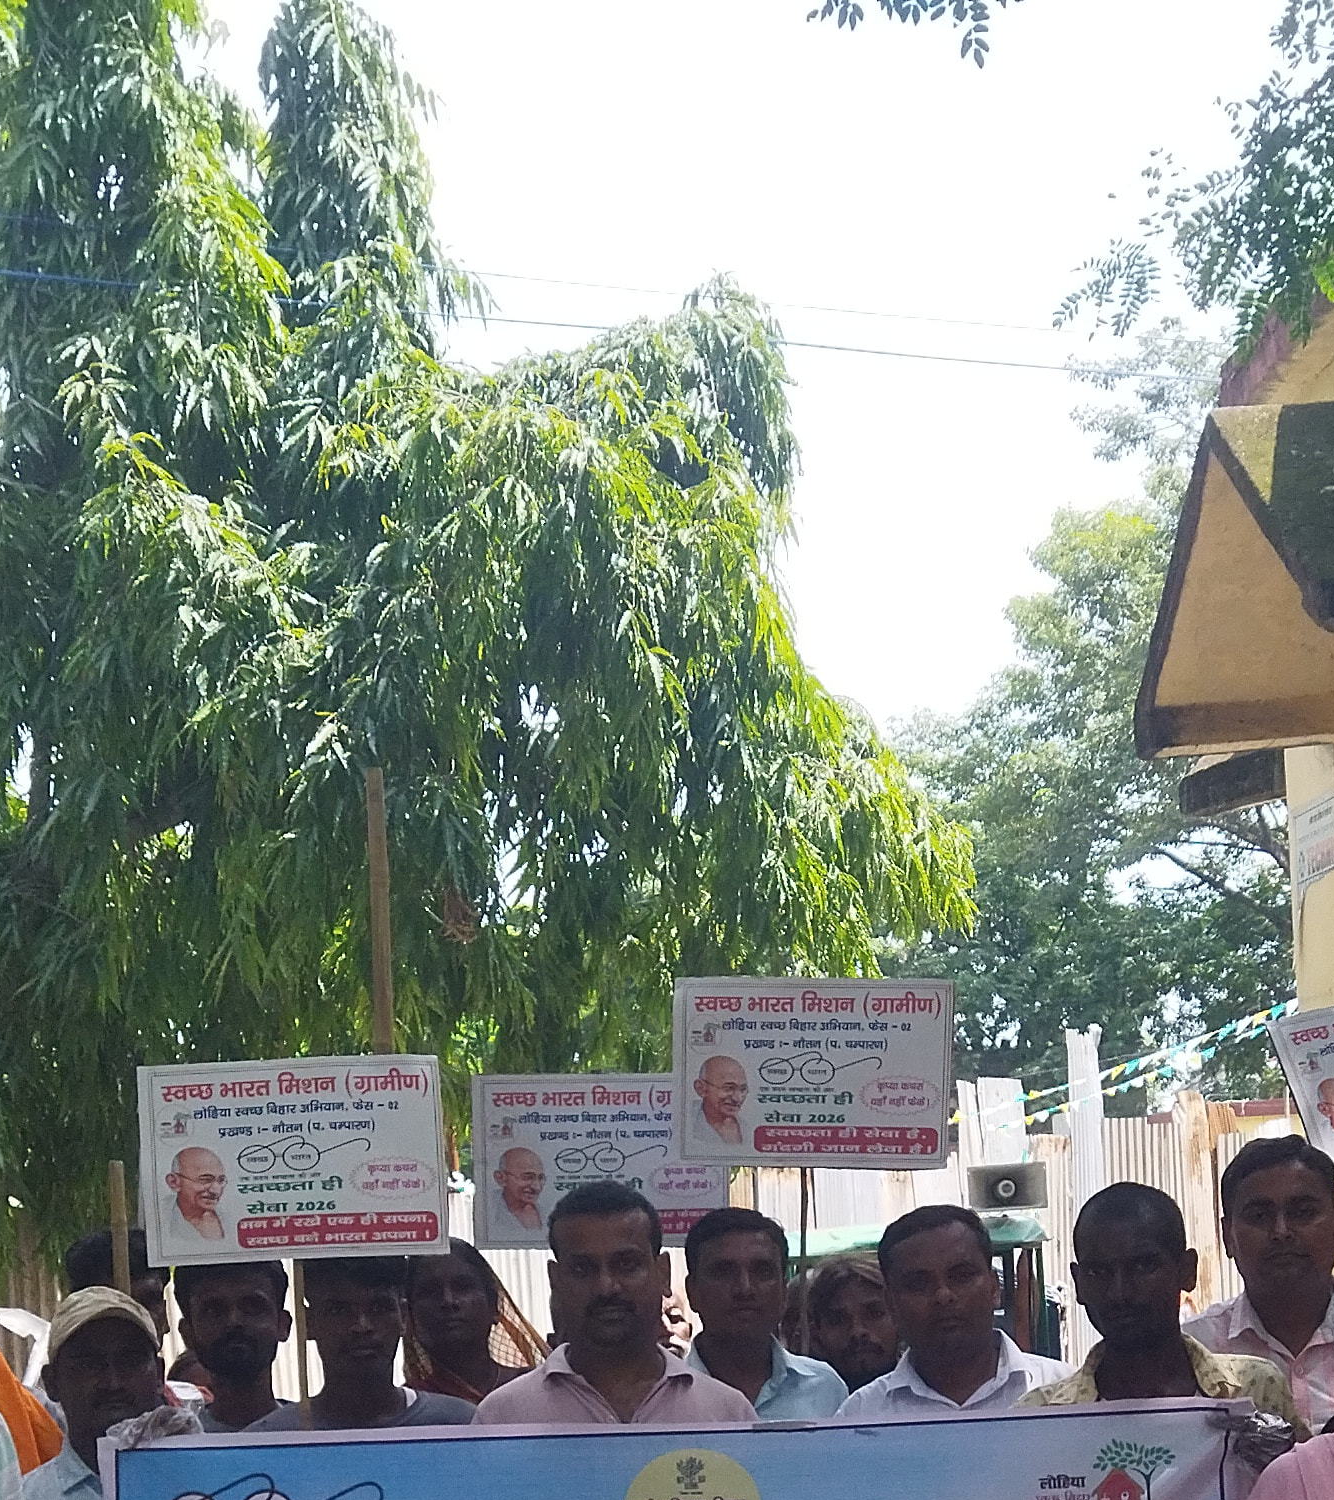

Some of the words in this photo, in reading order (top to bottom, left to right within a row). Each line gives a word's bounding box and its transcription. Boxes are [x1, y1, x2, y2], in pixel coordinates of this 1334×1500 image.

[695, 996, 742, 1013] स्वच्छ
[748, 995, 794, 1013] भारत
[802, 991, 855, 1013] मिशन
[863, 991, 941, 1019] (ग्रामीण)
[722, 1019, 757, 1031] लोहिया
[760, 1021, 786, 1032] स्वच्छ
[789, 1018, 816, 1031] बिहार
[868, 1019, 888, 1032] फेस
[744, 1039, 775, 1050] प्रखण्ड
[793, 1037, 821, 1049] नौतन
[1289, 1028, 1329, 1046] स्वच्छ
[162, 1084, 213, 1102] स्वच्छ
[220, 1079, 270, 1098] भारत
[277, 1071, 336, 1095] मिशन
[345, 1068, 429, 1098] (ग्रामीण)
[492, 1092, 537, 1107] स्वच्छ
[542, 1091, 585, 1106] भारत
[592, 1086, 641, 1106] मिशन
[758, 1094, 827, 1104] स्वच्छता
[833, 1091, 854, 1105] ही
[193, 1106, 232, 1120] लोहिया
[235, 1105, 263, 1117] स्वच्छ
[266, 1102, 296, 1115] बिहार
[352, 1098, 374, 1111] फेस
[764, 1111, 802, 1123] सेवा
[808, 1112, 845, 1123] 2026
[219, 1125, 252, 1138] प्रखण्ड
[272, 1120, 303, 1134] नौतन
[766, 1128, 831, 1138] स्वच्छता
[839, 1126, 857, 1139] ही
[864, 1128, 899, 1138] सेवा
[761, 1141, 814, 1153] गंदगी
[821, 1143, 860, 1153] जान
[866, 1142, 902, 1153] लेवा
[237, 1180, 314, 1194] स्वच्छता
[321, 1176, 343, 1190] ही
[247, 1200, 288, 1215] सेवा
[296, 1200, 336, 1212] 2026
[240, 1219, 267, 1230] मन
[327, 1215, 354, 1226] एक
[361, 1213, 378, 1226] ही
[246, 1234, 289, 1246] स्वच्छ
[324, 1231, 367, 1242] भारत
[372, 1230, 418, 1241] अपना
[1039, 1474, 1087, 1489] लोहिया
